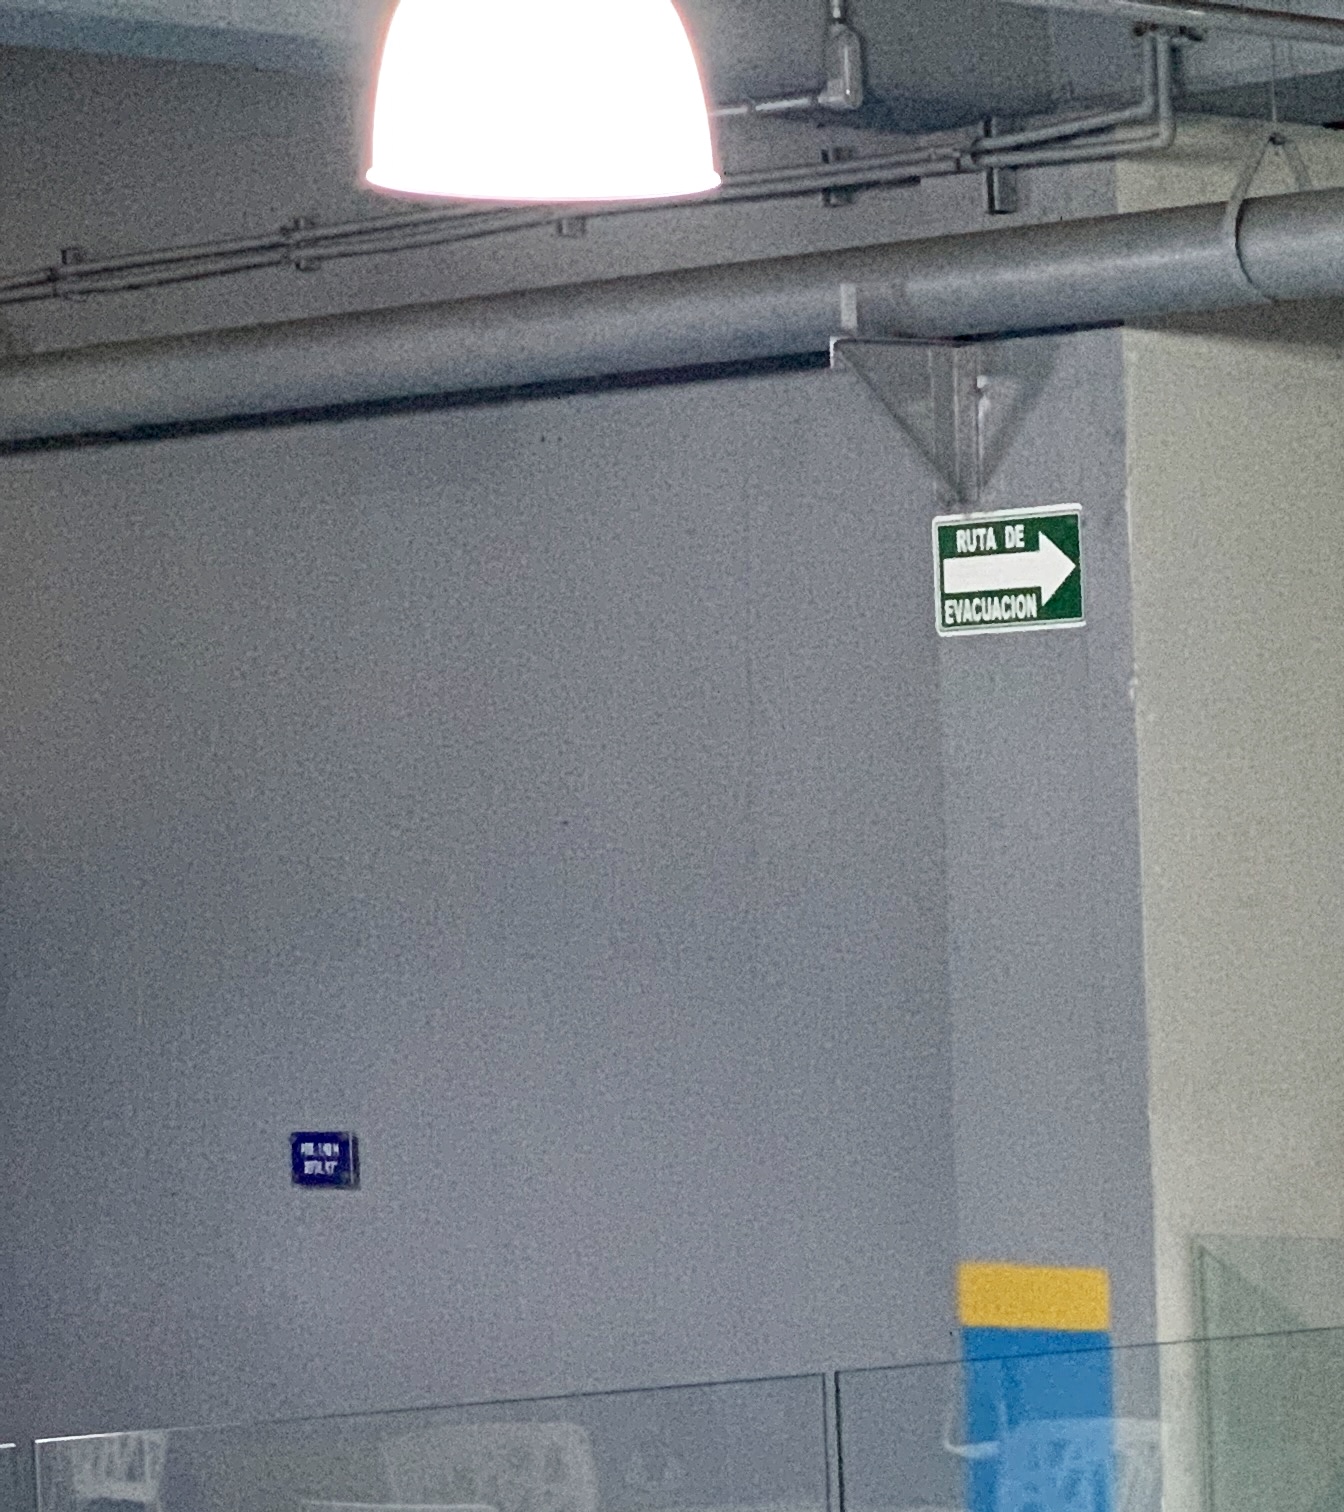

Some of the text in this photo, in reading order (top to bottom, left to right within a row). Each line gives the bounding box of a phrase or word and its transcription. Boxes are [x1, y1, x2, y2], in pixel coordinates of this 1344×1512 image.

[955, 524, 1026, 553] RUTA DE
[944, 593, 1038, 625] EVACUACION
